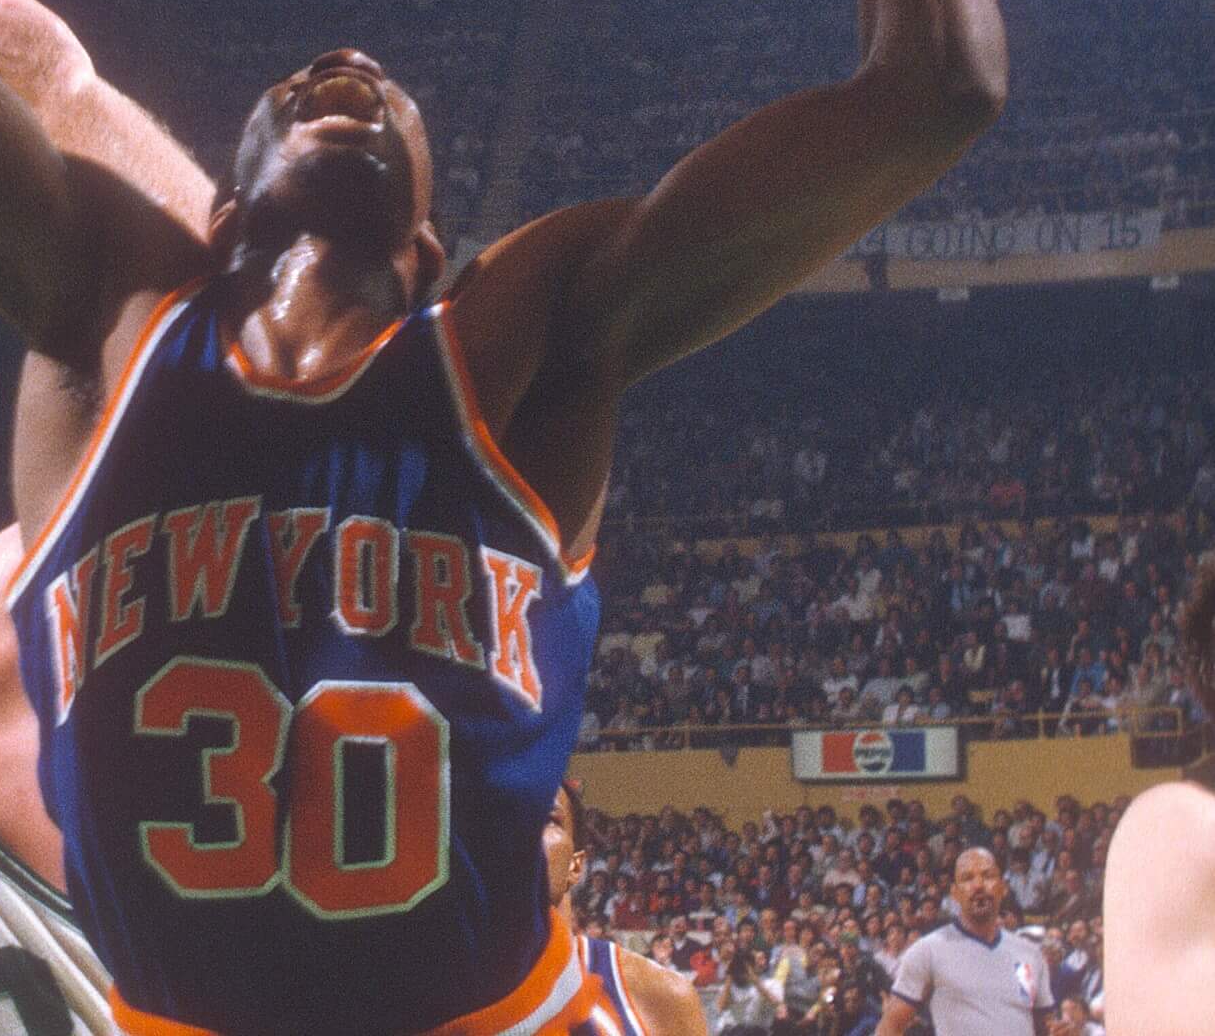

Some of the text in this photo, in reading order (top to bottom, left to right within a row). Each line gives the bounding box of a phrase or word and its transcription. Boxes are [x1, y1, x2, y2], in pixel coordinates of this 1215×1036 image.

[45, 495, 544, 728] NEW YORK
[134, 655, 451, 921] 30
